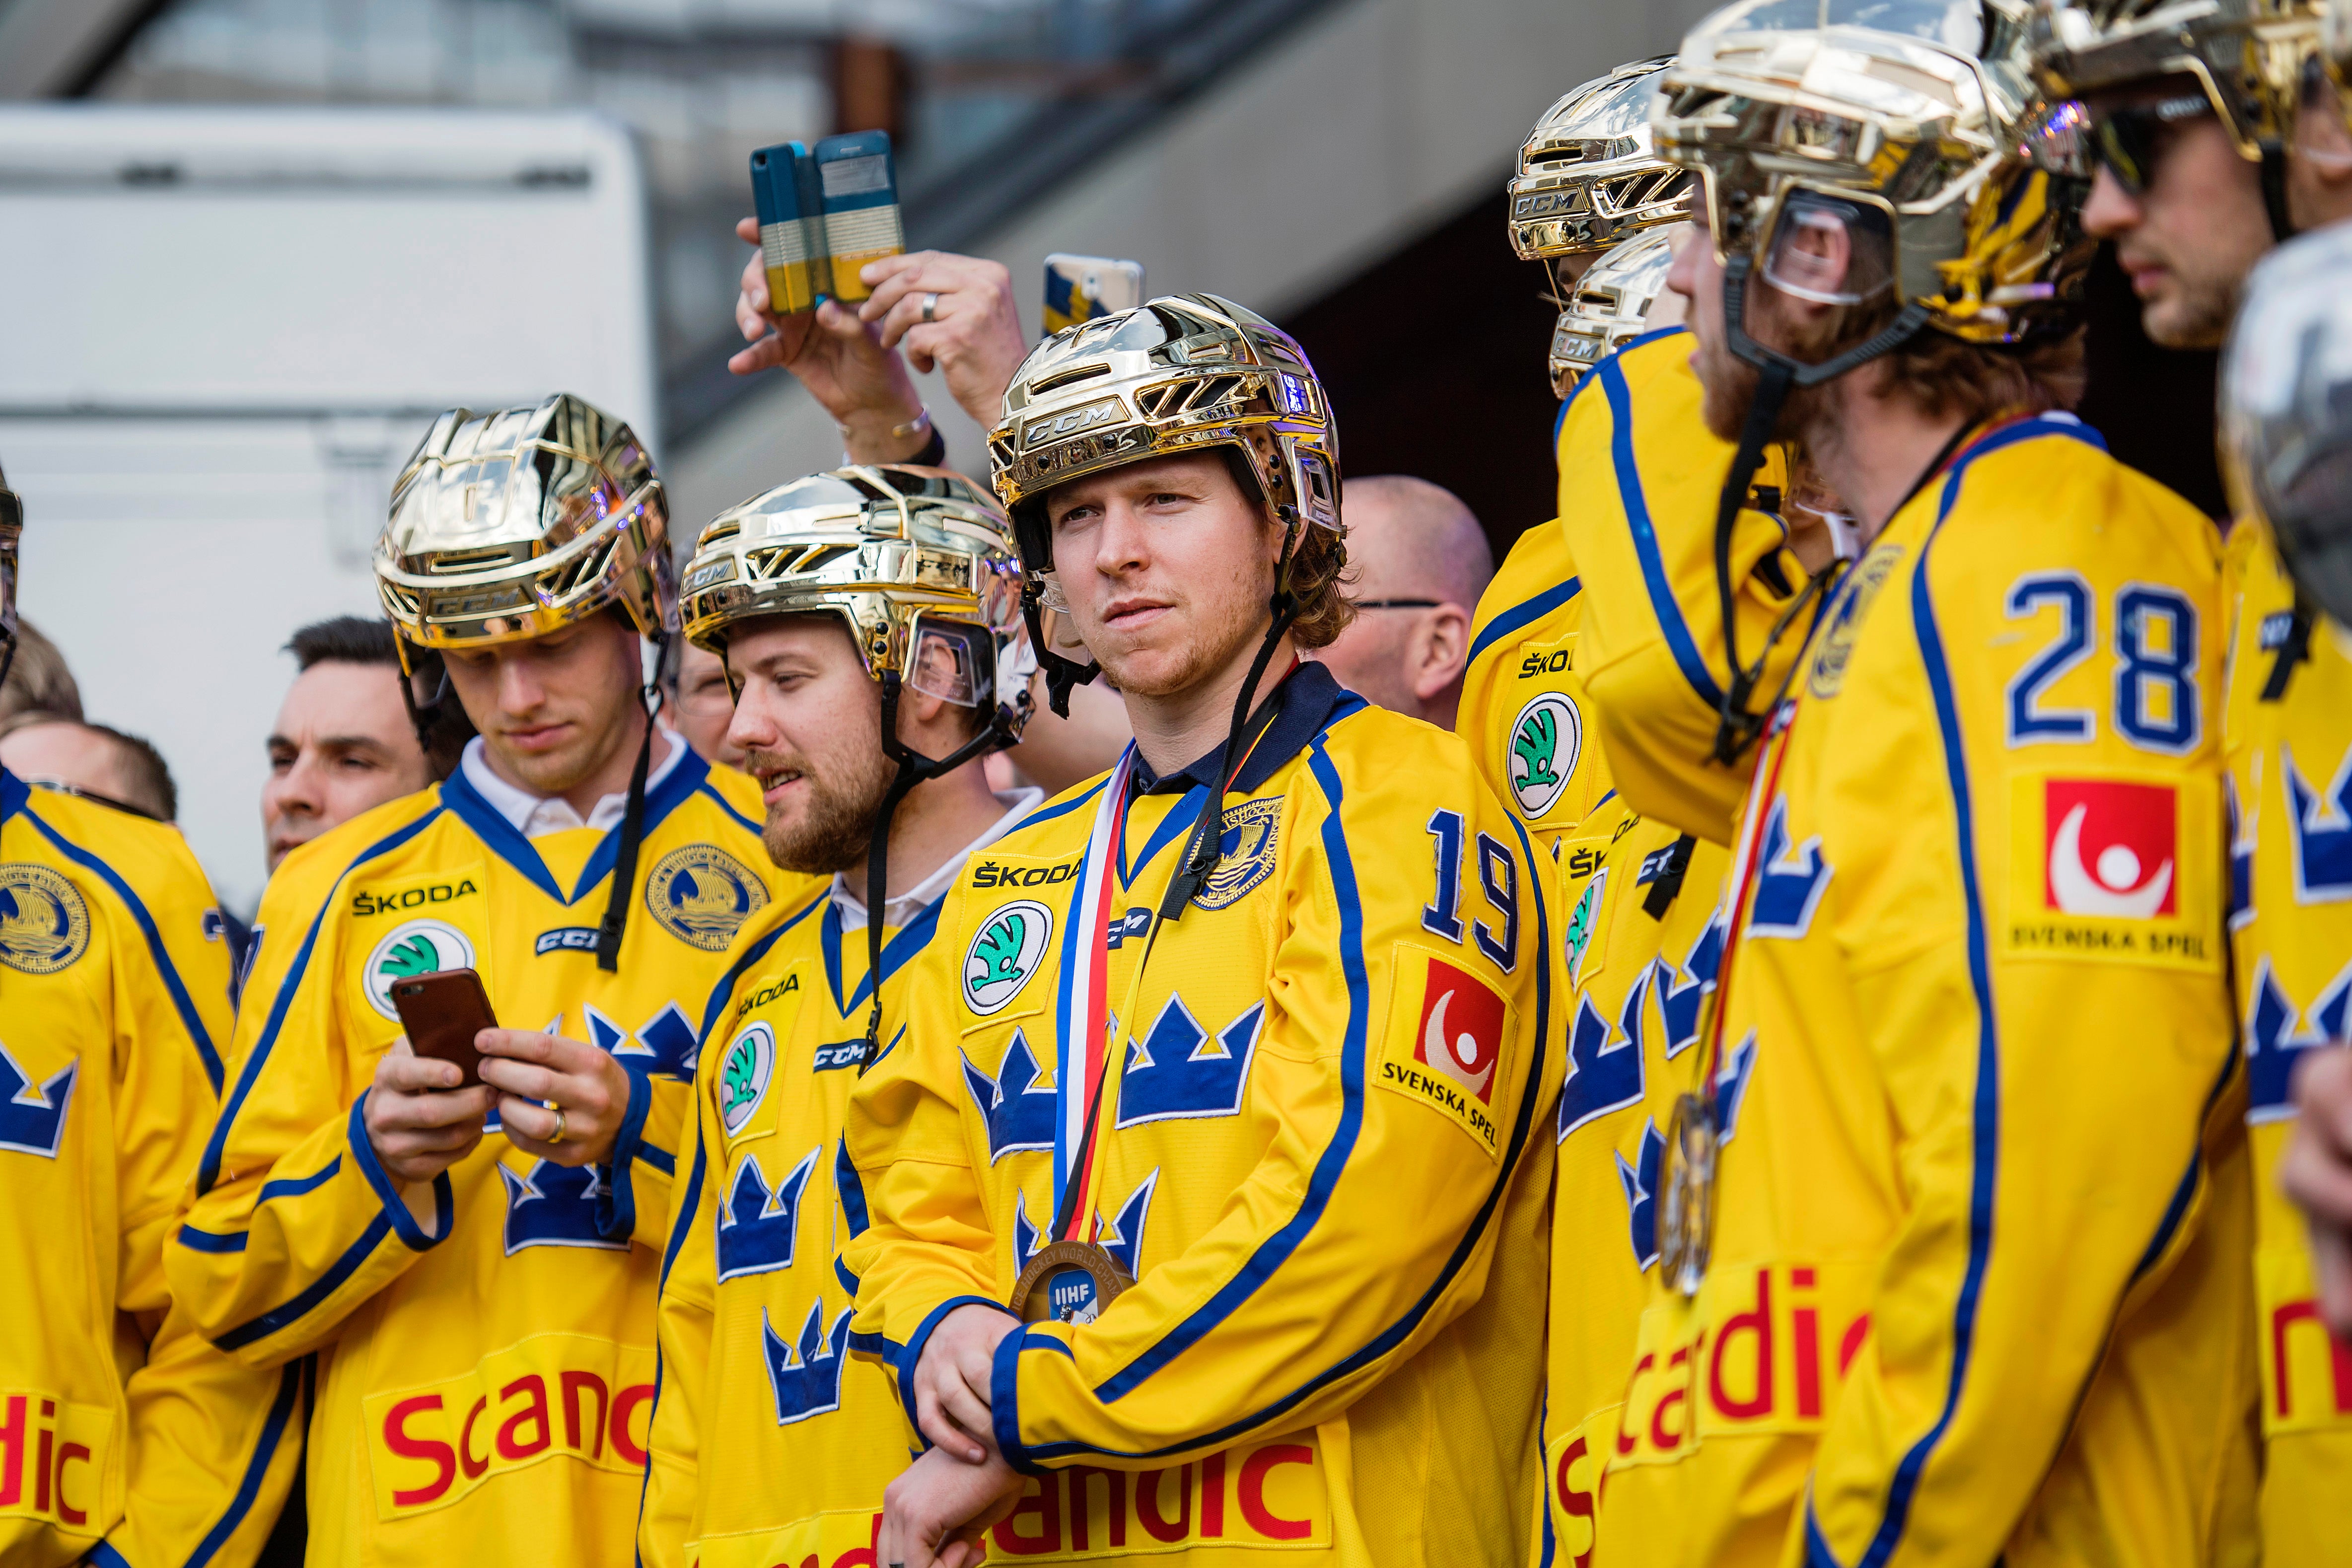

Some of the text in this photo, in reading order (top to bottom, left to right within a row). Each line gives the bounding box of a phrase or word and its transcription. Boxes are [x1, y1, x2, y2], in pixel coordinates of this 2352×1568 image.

[1516, 192, 1578, 215] CCM
[1554, 336, 1601, 358] CCM
[1027, 403, 1116, 444] CCM
[683, 563, 730, 592] CCM
[1518, 649, 1575, 679] ŠKO
[2004, 569, 2203, 757] 28
[352, 880, 477, 917] ŠKODA
[1422, 807, 1520, 974] 19
[537, 929, 598, 952] CC
[1382, 1062, 1497, 1148] SVENSKA SPEL
[1012, 1289, 1026, 1311] ICE
[1021, 1250, 1057, 1289] HOCKEY
[1059, 1247, 1096, 1268] WORLD
[1055, 1283, 1089, 1306] IIHF
